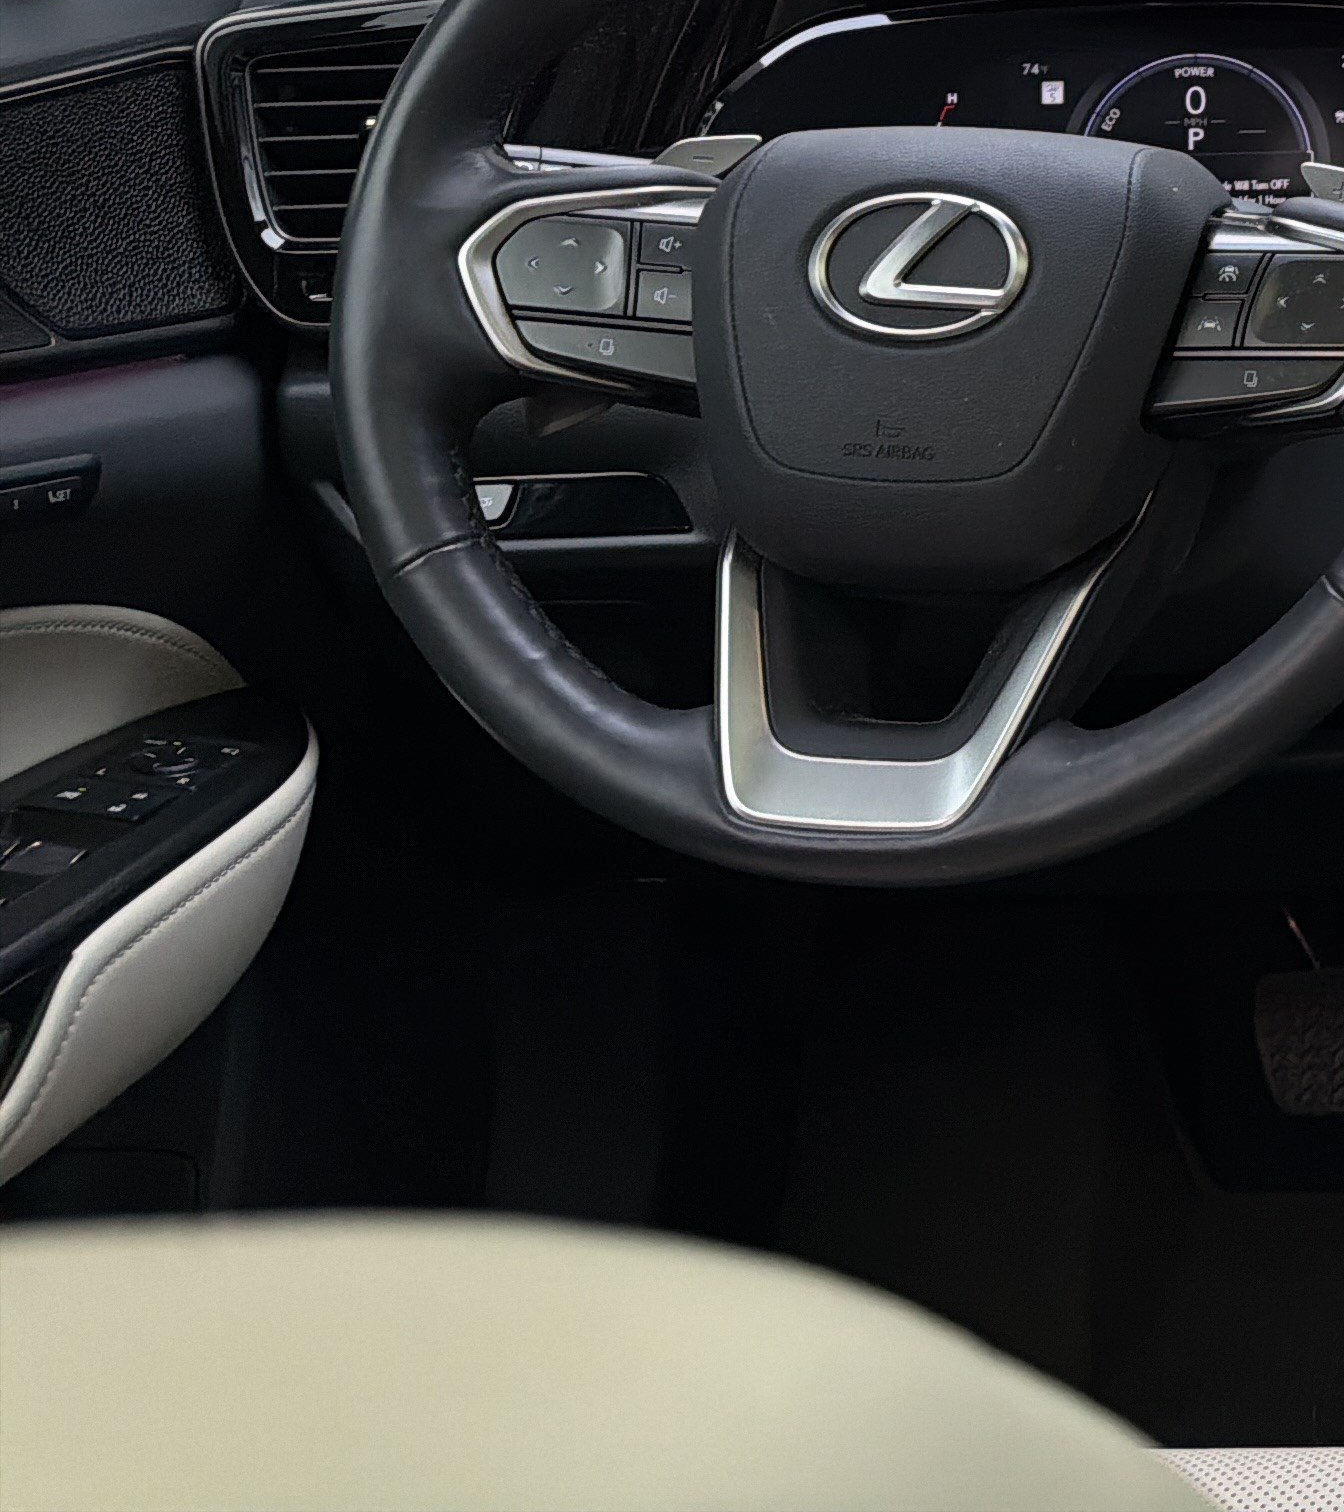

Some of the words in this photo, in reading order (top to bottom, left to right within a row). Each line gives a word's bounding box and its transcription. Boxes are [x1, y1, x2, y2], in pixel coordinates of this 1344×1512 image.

[1174, 66, 1216, 78] POWER
[946, 92, 958, 104] H
[1184, 86, 1207, 115] 0
[1101, 107, 1121, 132] ECO
[1184, 117, 1208, 127] MPH
[1187, 128, 1205, 150] P
[1270, 178, 1290, 190] OFF
[842, 442, 873, 458] SRS
[875, 444, 936, 461] AIRBAG
